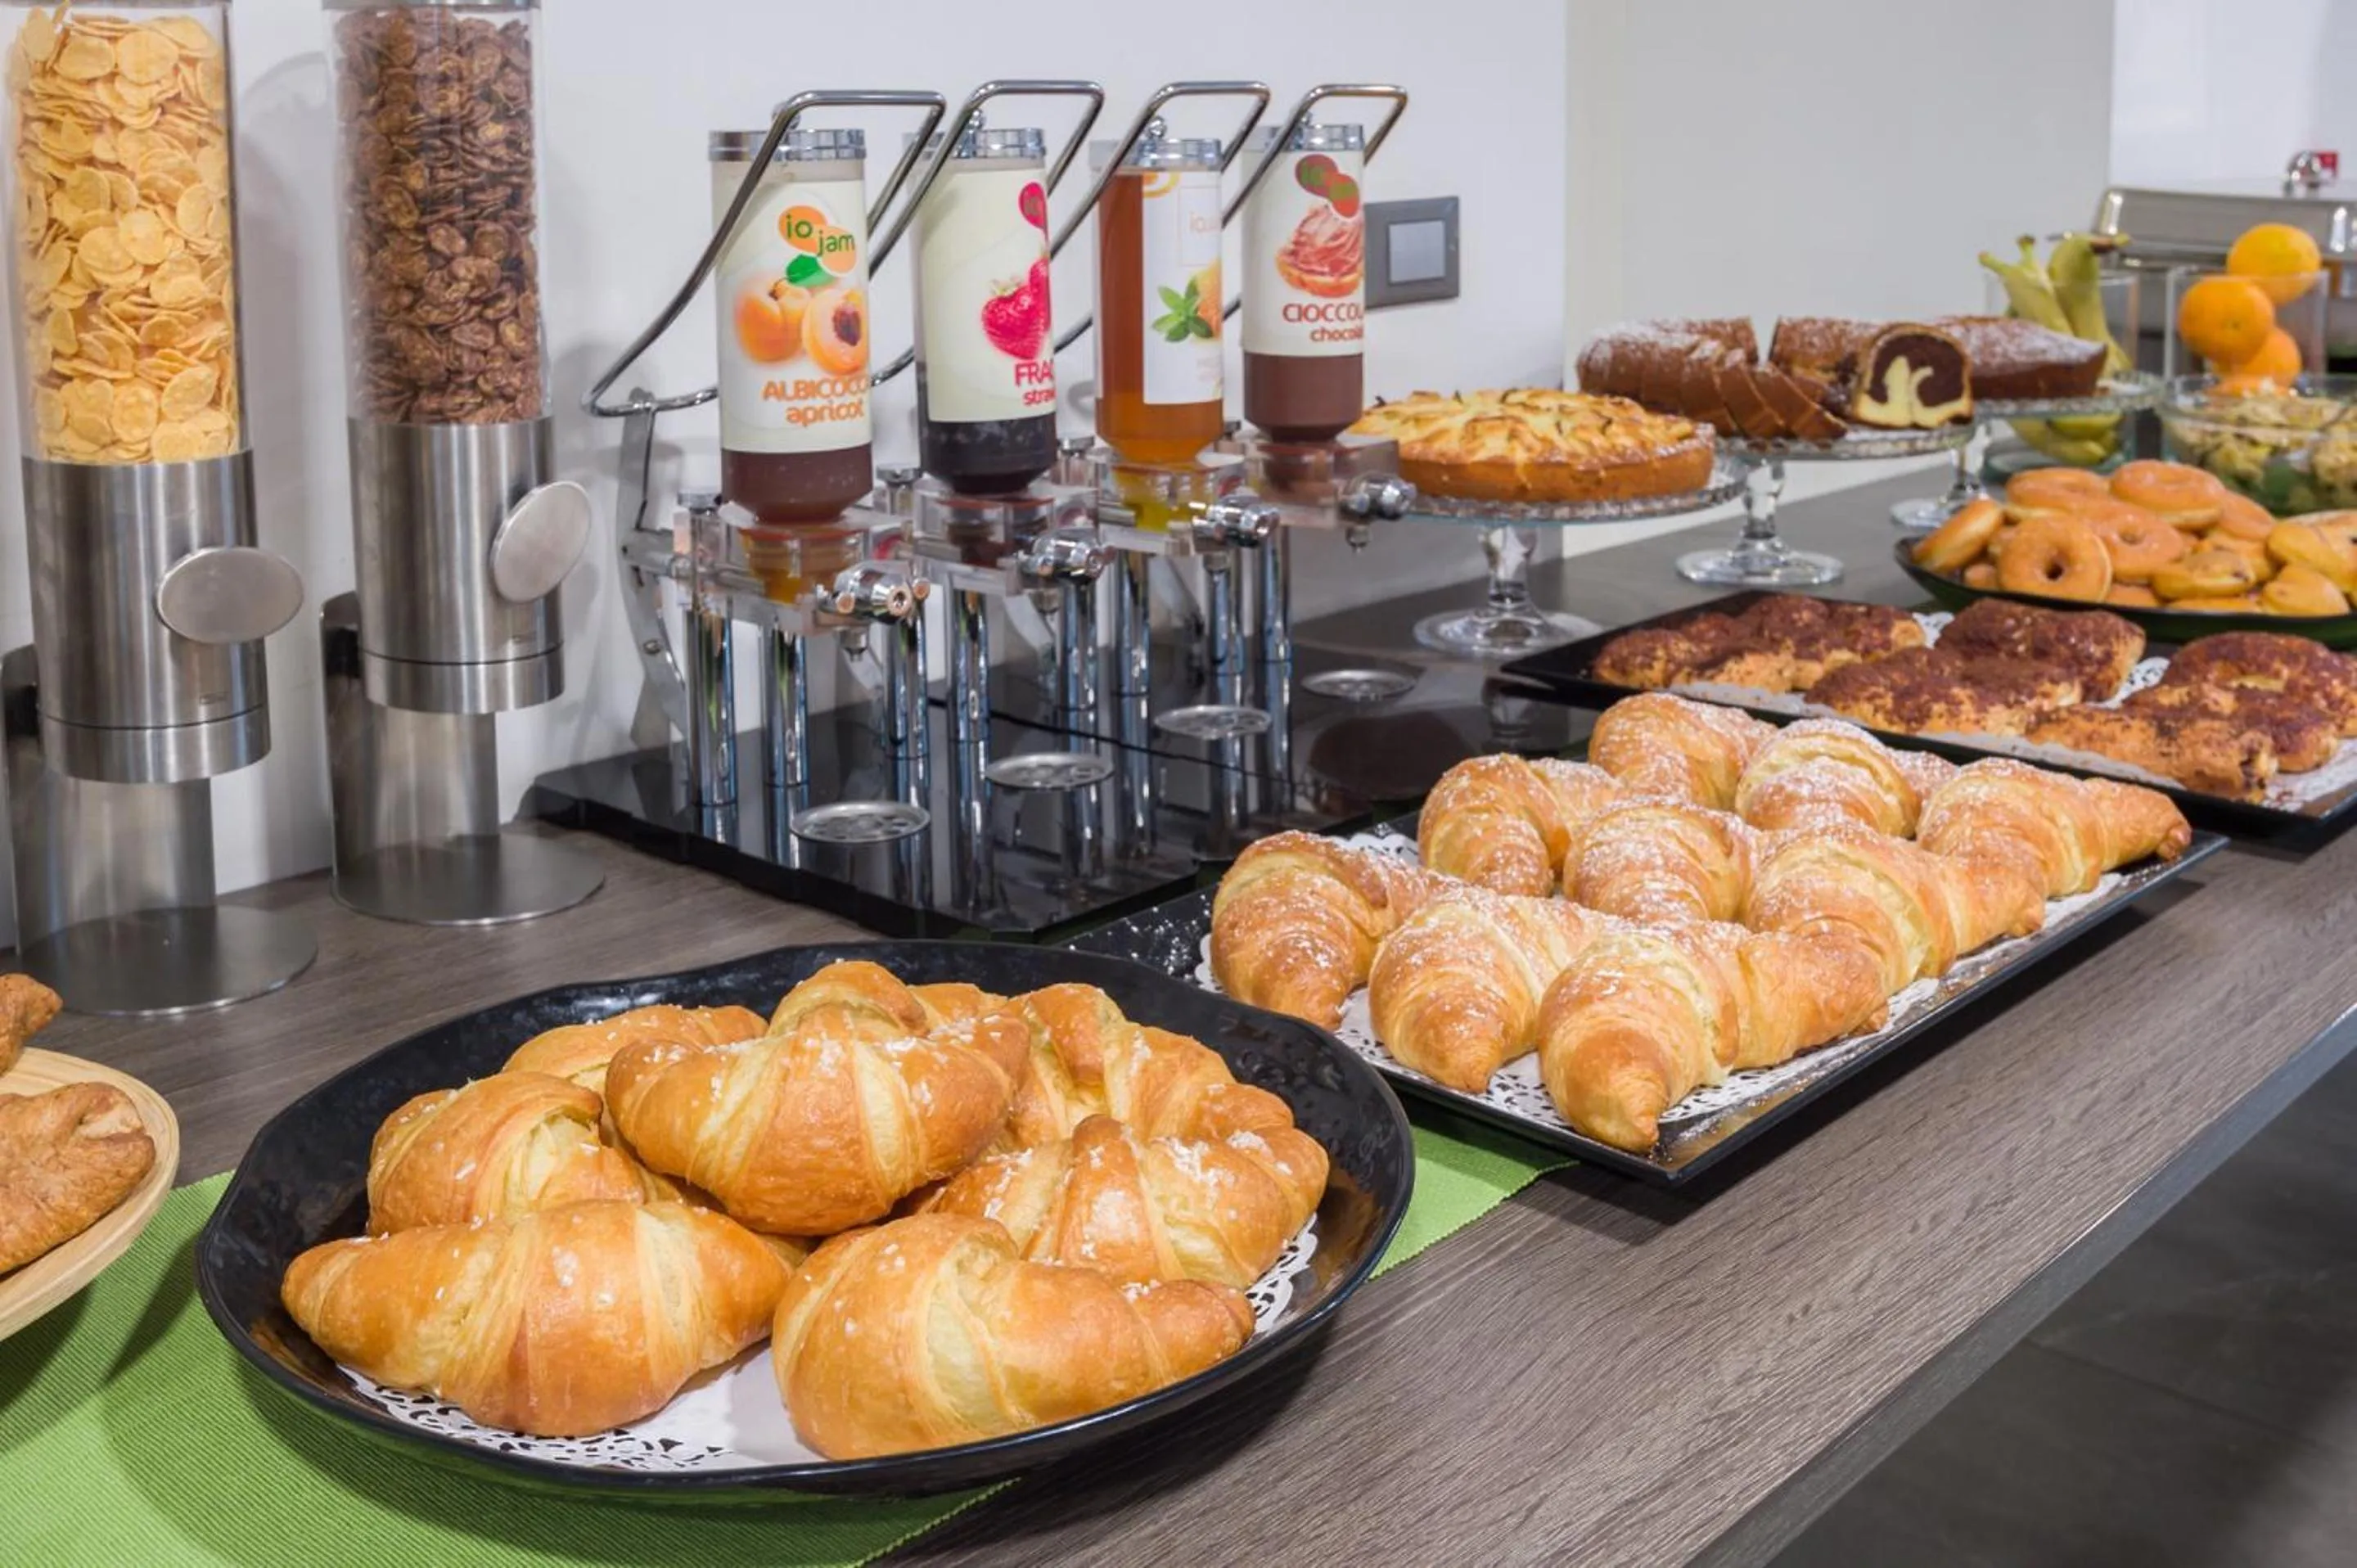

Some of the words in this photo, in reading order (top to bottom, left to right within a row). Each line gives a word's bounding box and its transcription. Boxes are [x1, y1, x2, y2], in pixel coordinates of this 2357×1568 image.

[786, 213, 813, 240] io
[817, 229, 856, 258] jam
[1016, 359, 1055, 386] FRA
[786, 397, 864, 427] apricot
